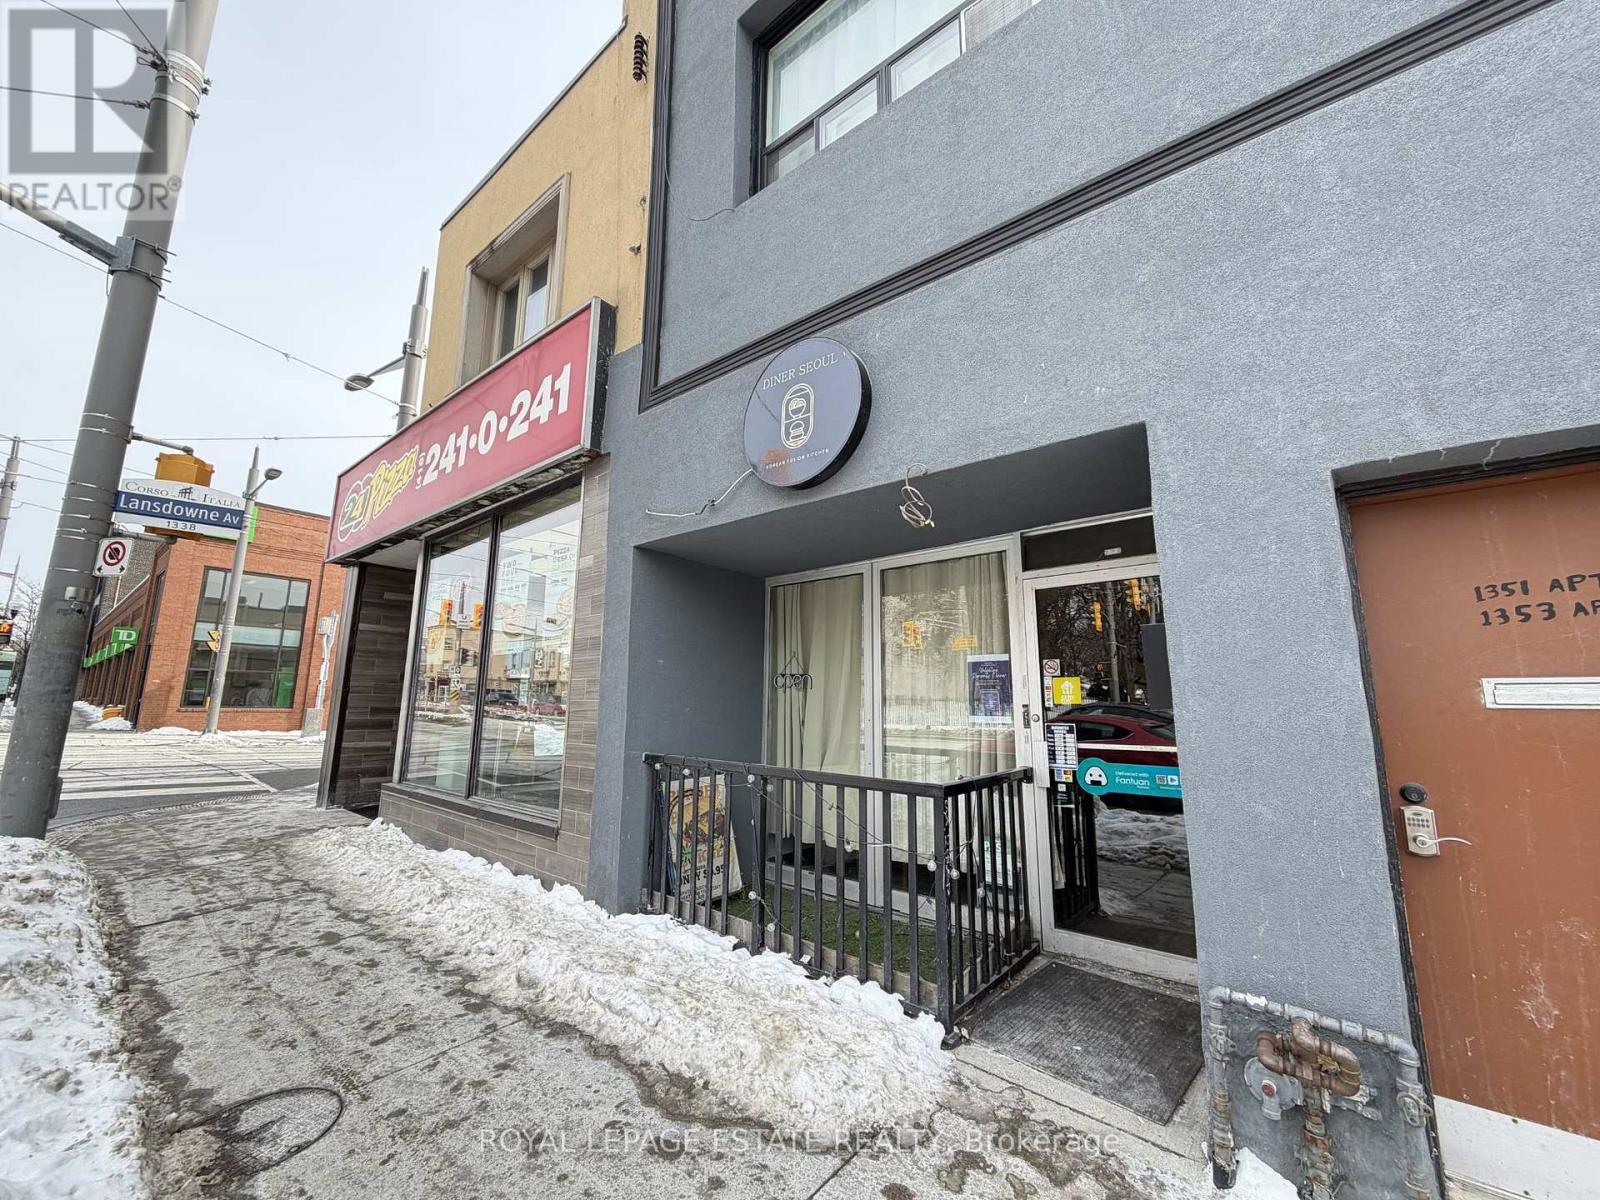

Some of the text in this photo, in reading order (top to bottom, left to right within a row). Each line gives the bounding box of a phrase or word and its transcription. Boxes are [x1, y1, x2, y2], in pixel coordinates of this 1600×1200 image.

[762, 352, 838, 391] DINER SEOUL
[125, 481, 242, 508] CORSO ITALIA
[119, 494, 240, 525] Lansdowne Av
[166, 520, 196, 531] 1338
[1474, 579, 1530, 603] 1351
[1480, 602, 1557, 626] 1353
[115, 629, 137, 641] TD
[1115, 776, 1150, 786] Fantuan
